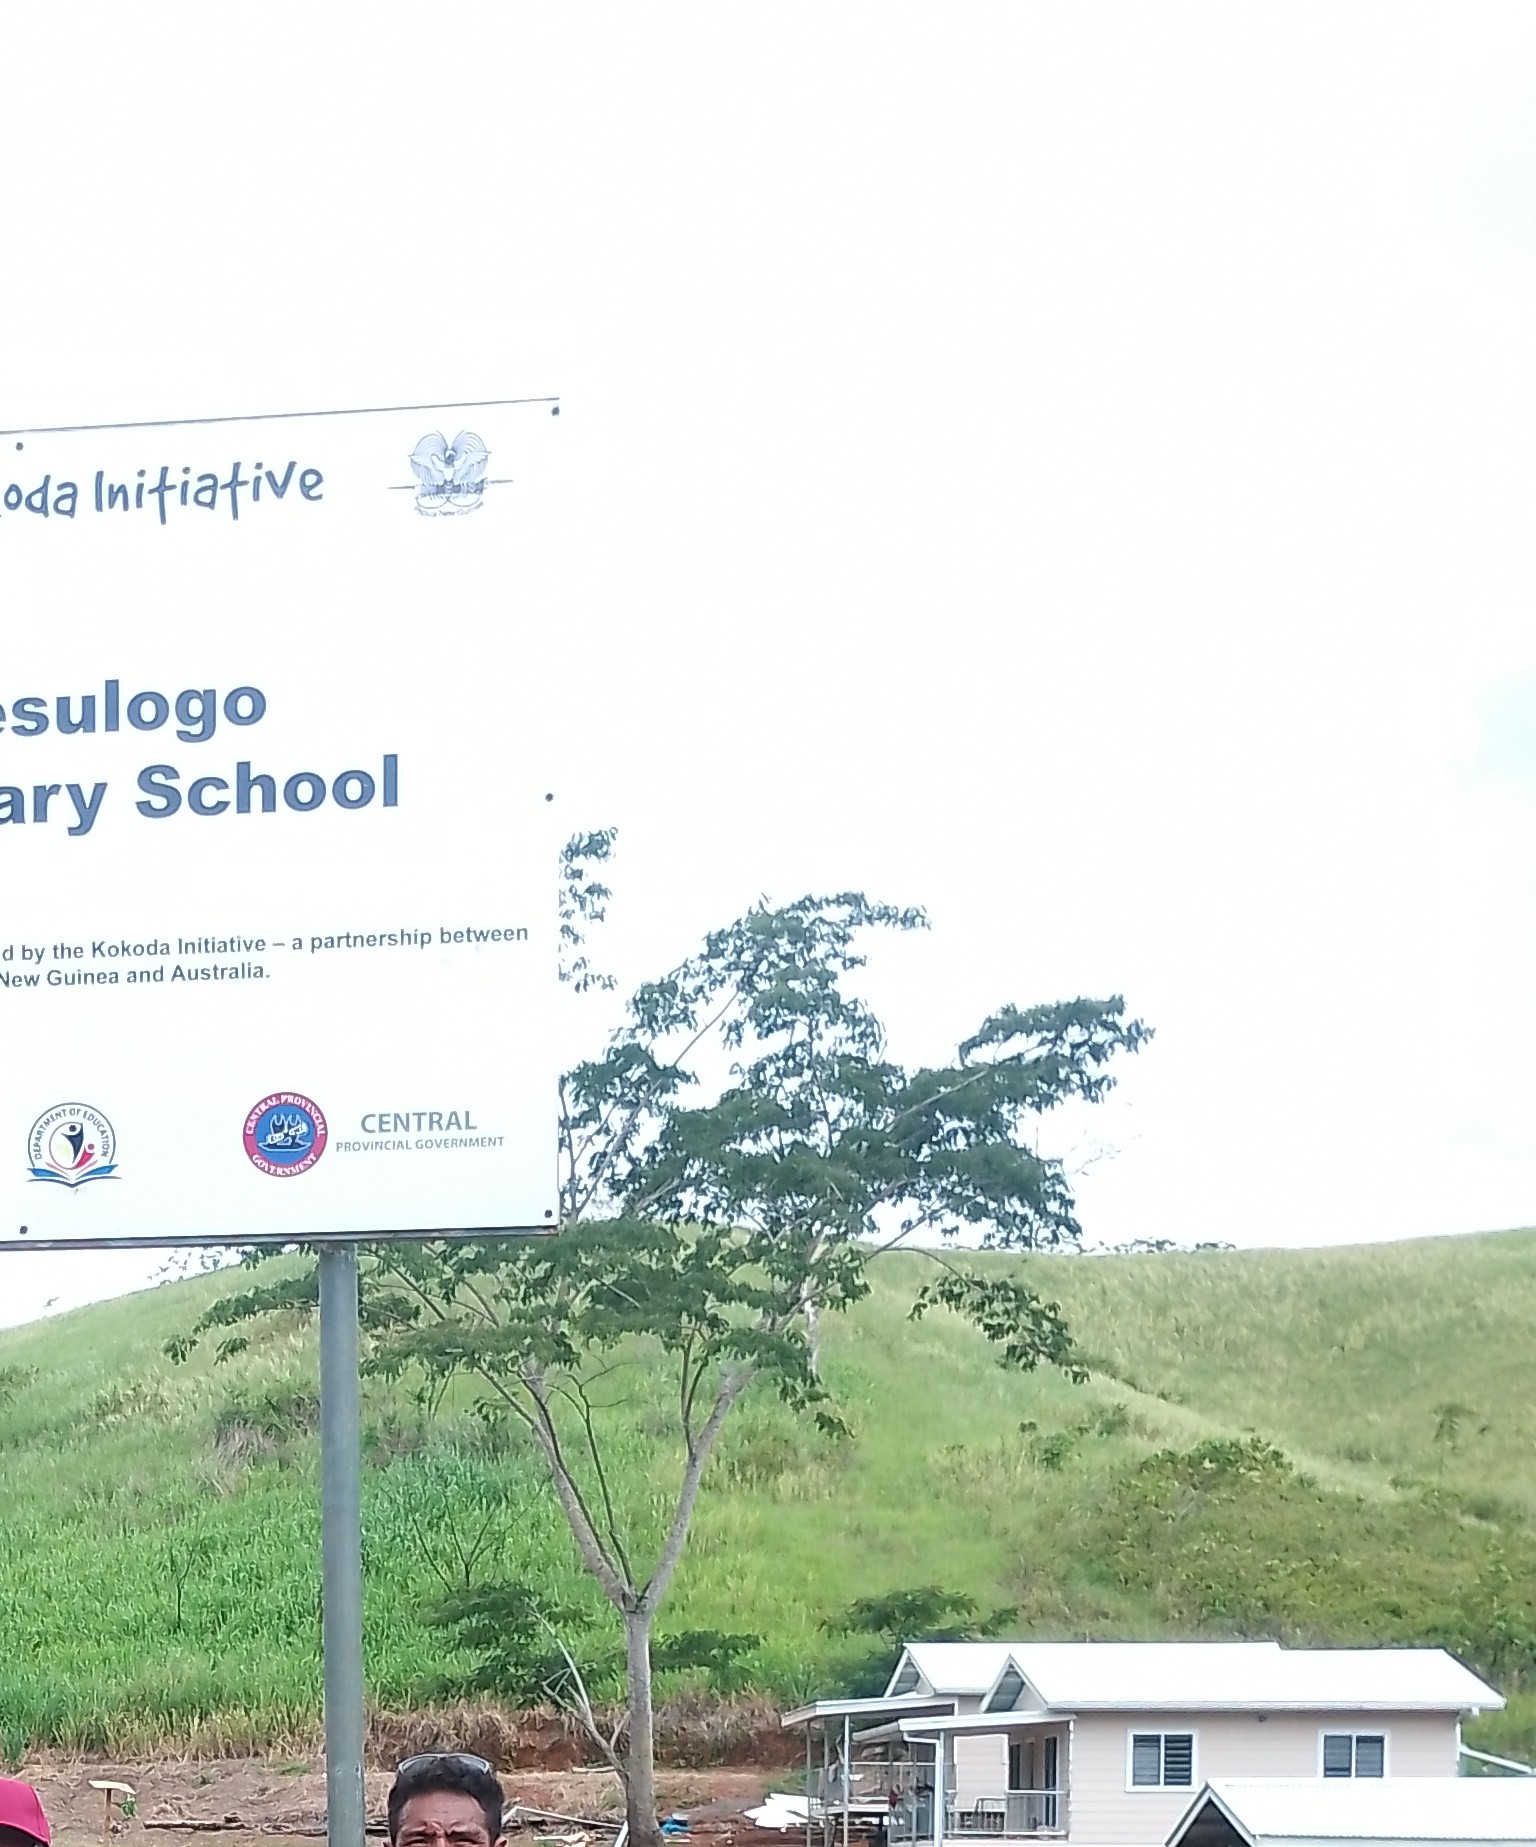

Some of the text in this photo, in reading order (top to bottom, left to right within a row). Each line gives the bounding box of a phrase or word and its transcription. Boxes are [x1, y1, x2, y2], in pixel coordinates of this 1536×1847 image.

[95, 461, 323, 525] Initiative
[135, 754, 398, 819] School
[22, 945, 45, 964] by
[53, 943, 83, 959] the
[92, 939, 170, 958] Kokoda
[178, 936, 266, 954] Initiative
[292, 938, 302, 950] a
[311, 929, 432, 954] partnership
[440, 927, 528, 944] between
[47, 969, 118, 986] Guinea
[127, 965, 163, 983] and
[171, 962, 270, 982] Australia.
[361, 1111, 477, 1134] CENTRAL
[336, 1137, 504, 1152] PROVINCIAL GOVERNMENT
